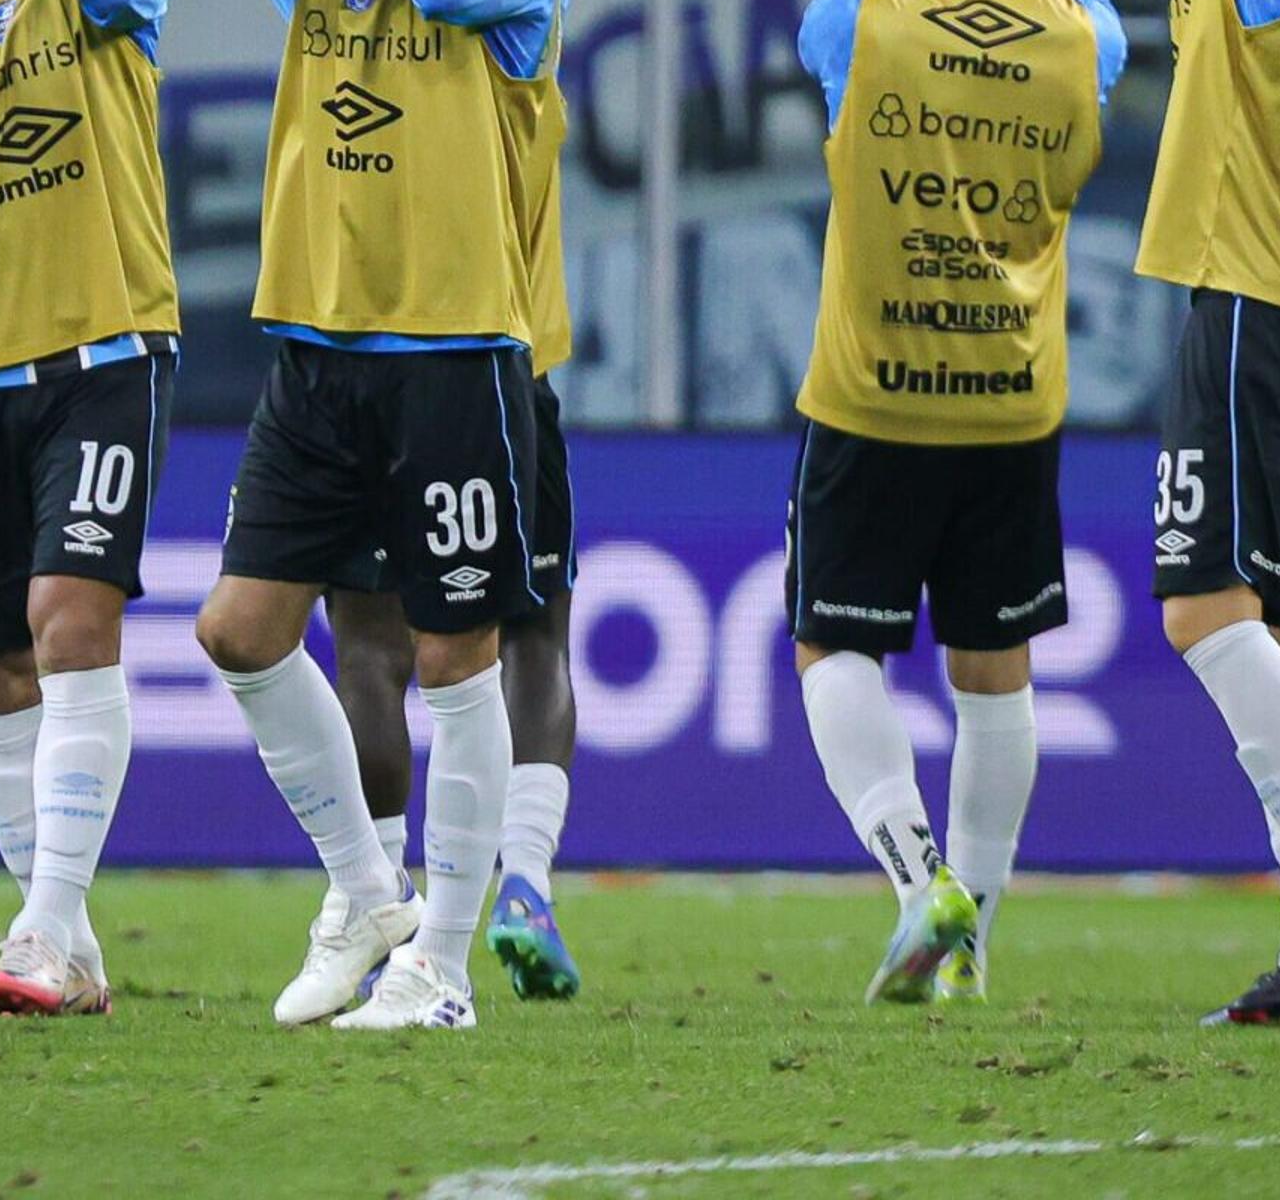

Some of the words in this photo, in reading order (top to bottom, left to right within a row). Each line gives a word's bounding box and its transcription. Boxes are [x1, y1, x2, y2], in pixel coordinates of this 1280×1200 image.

[929, 52, 1031, 83] umbro
[920, 102, 1074, 154] banrisul
[880, 168, 999, 214] vero
[877, 360, 1033, 395] Unimed
[69, 440, 135, 516] 10
[1154, 449, 1205, 526] 35
[424, 477, 498, 557] 30
[63, 541, 105, 557] umbro
[1154, 552, 1191, 567] umbro
[444, 587, 486, 602] umbro
